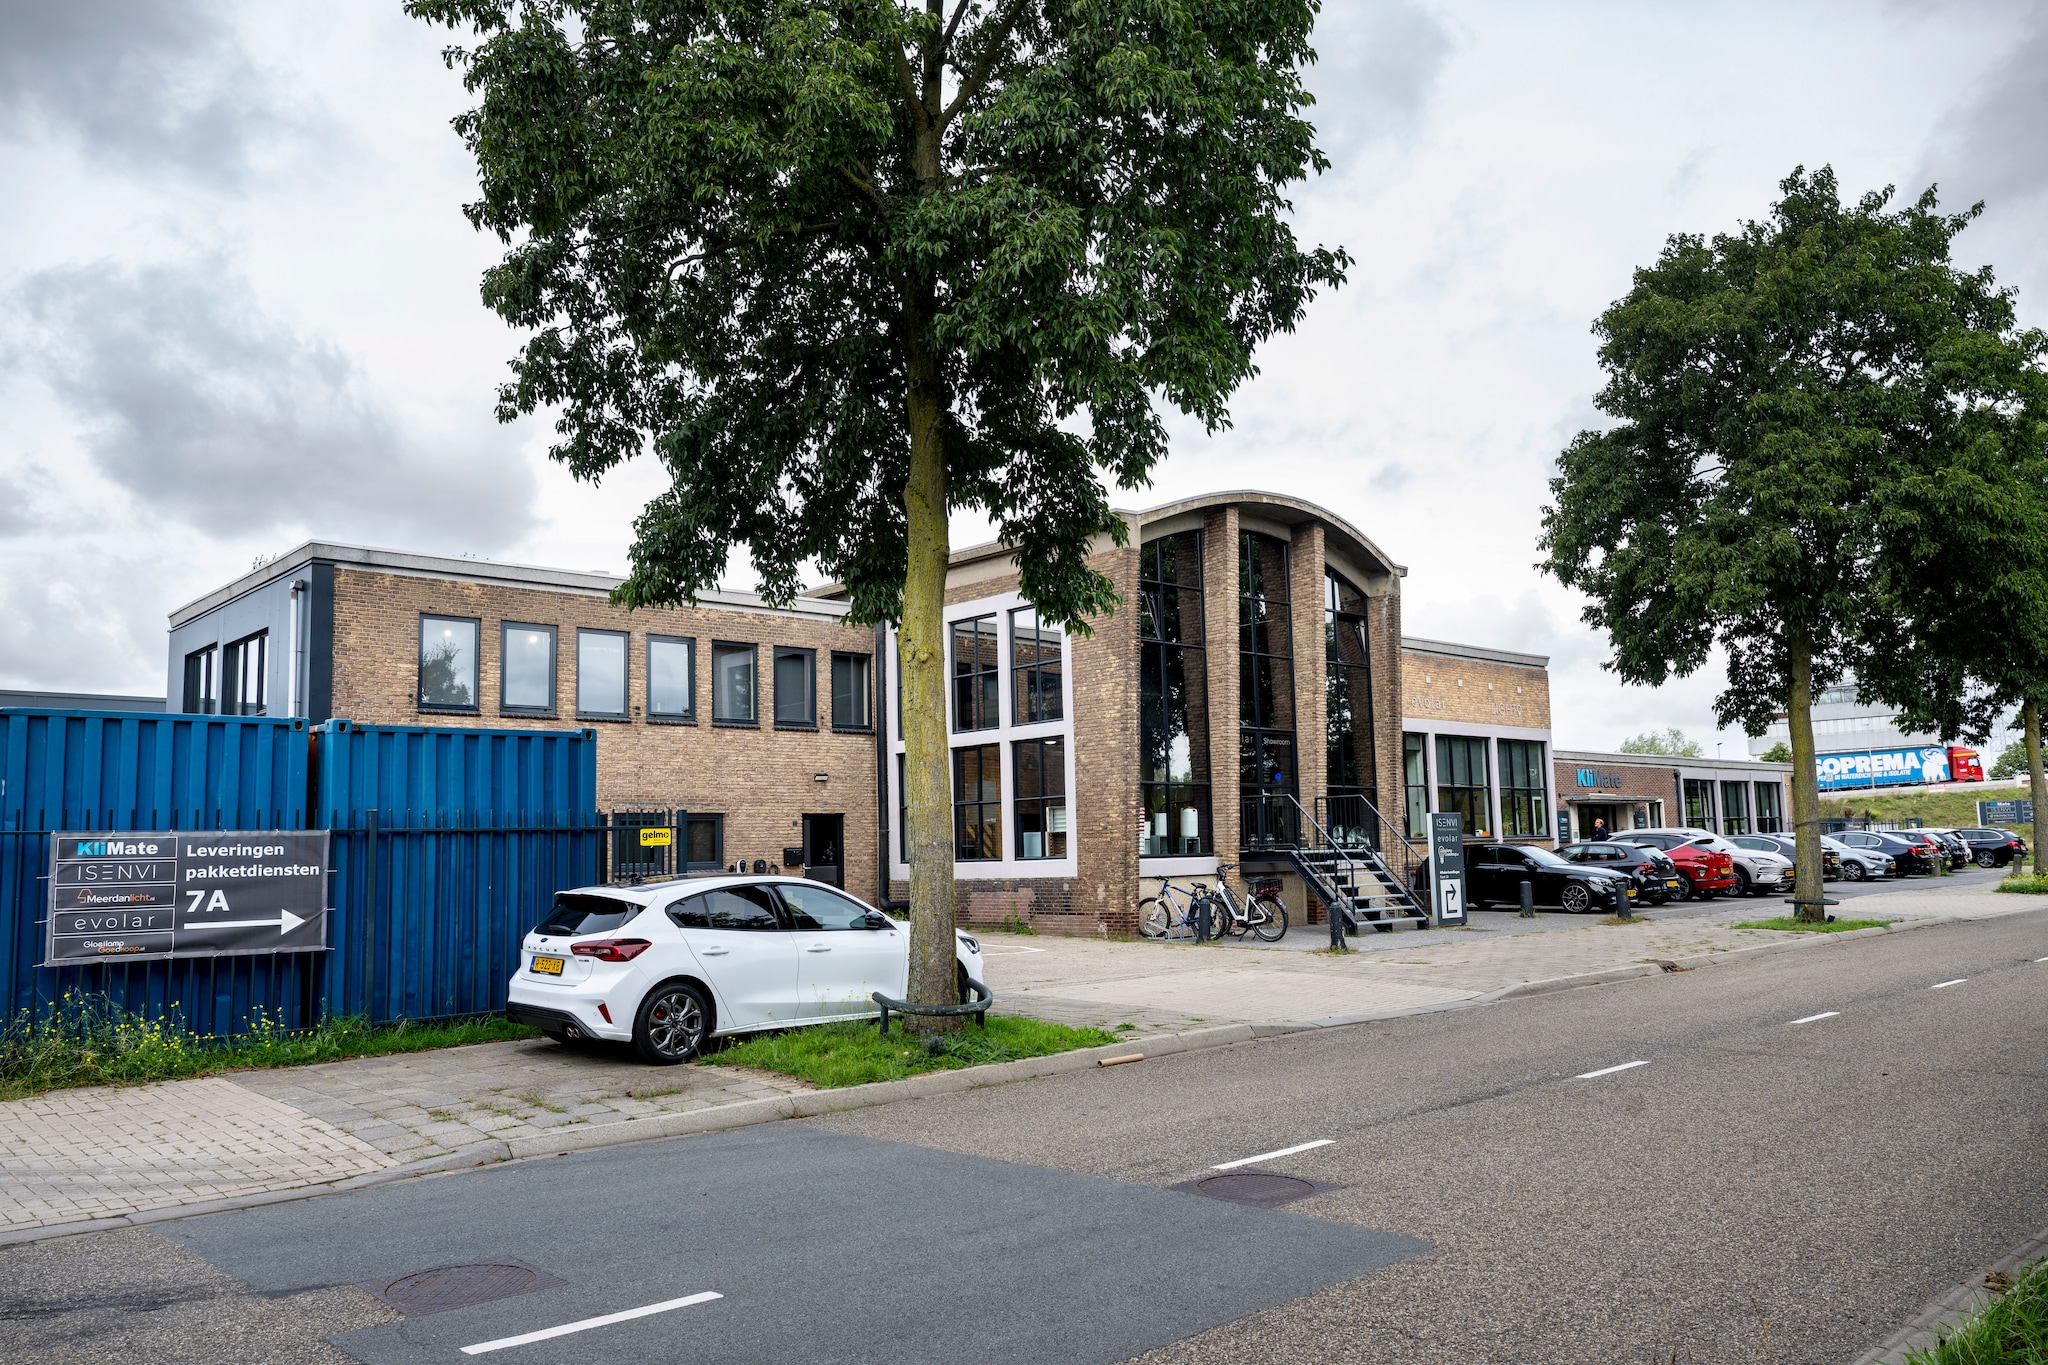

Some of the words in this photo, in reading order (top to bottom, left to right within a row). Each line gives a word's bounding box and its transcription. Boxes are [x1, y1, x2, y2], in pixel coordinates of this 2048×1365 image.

[1262, 737, 1291, 746] Showroom
[1576, 768, 1623, 788] KliMate
[1841, 771, 1882, 780] WATERDICHING
[1436, 818, 1459, 828] ISENVI
[1437, 833, 1459, 843] evolar
[77, 841, 158, 856] KliMate
[186, 844, 285, 858] Leveringen
[77, 864, 156, 880] ISENVI
[185, 864, 320, 882] pakketdiensten
[86, 893, 155, 904] Meerdanlicht.nl
[185, 889, 230, 913] 7A
[74, 913, 155, 930] evolar
[83, 939, 125, 949] Gloeilamp
